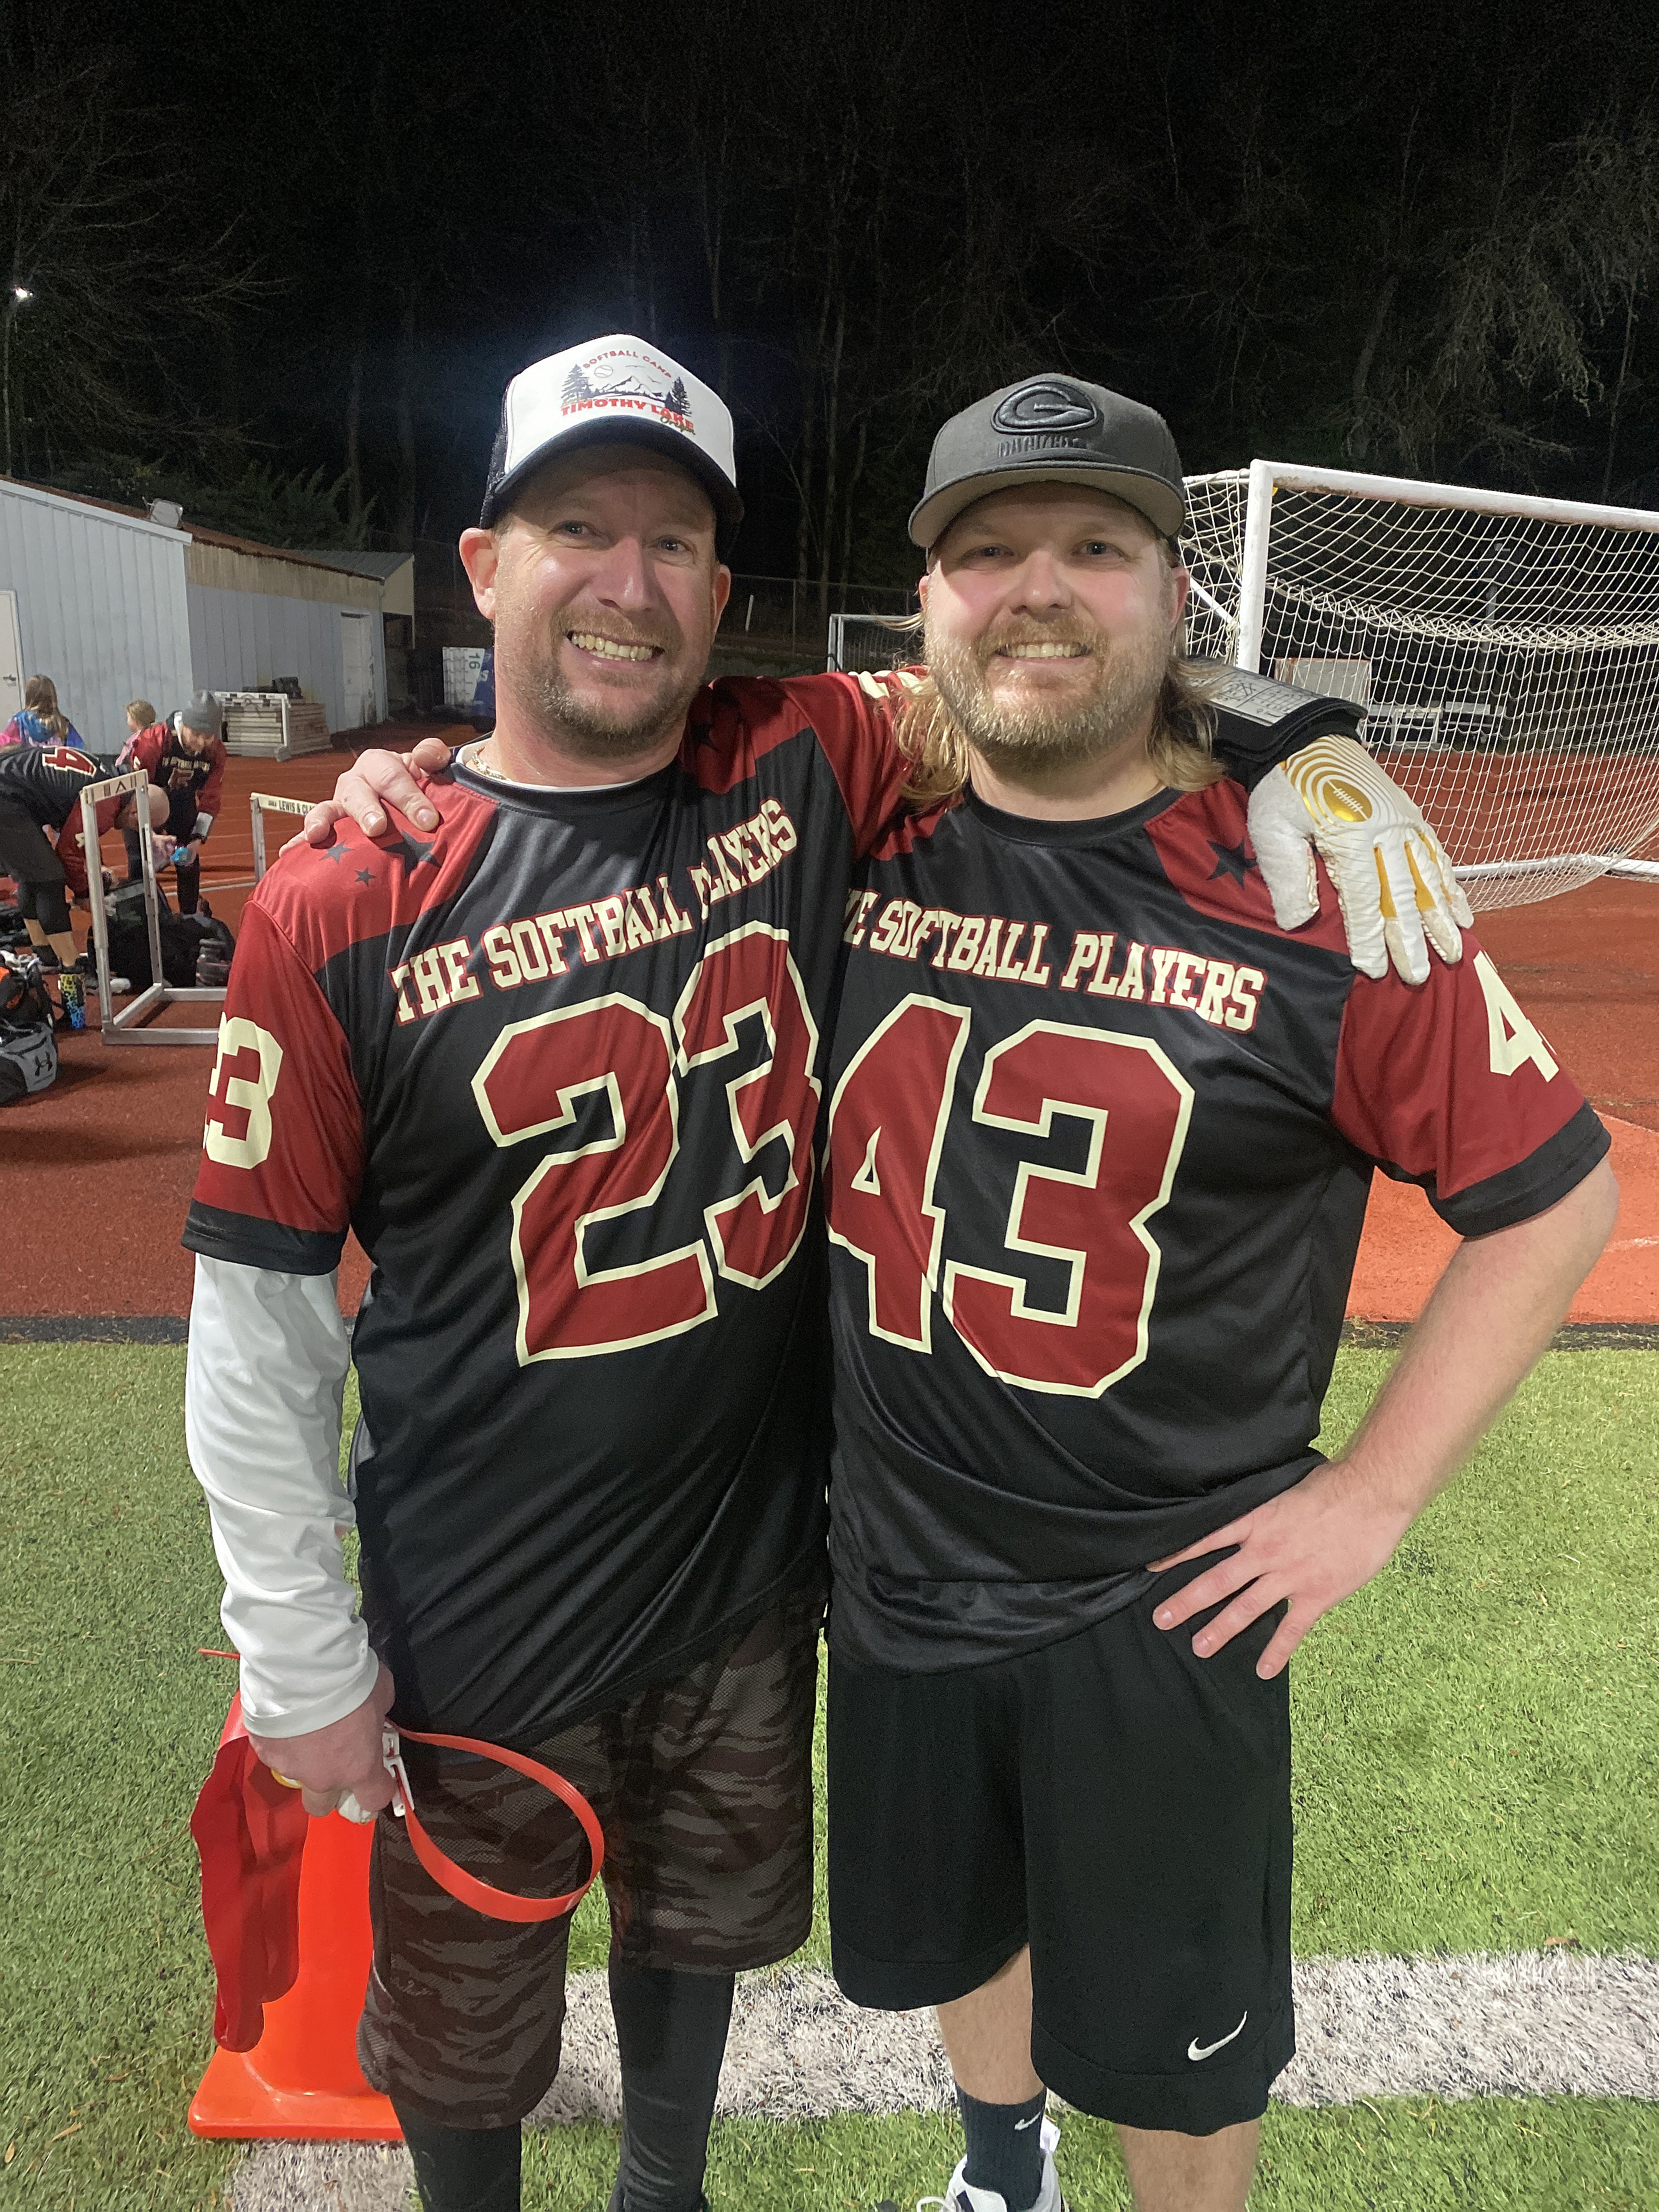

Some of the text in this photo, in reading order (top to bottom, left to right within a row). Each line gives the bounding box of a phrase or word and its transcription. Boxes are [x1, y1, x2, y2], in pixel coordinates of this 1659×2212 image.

[561, 399, 694, 430] TIMOTHY LAKE
[583, 350, 638, 369] SOFTBALL
[279, 800, 295, 812] LEWIS
[388, 936, 483, 1026] THE
[482, 874, 694, 990] SOFTBALL
[870, 897, 1053, 989] SOFTBALL
[1058, 930, 1267, 1032] PLAYERS
[471, 920, 822, 1367] 23
[822, 993, 1195, 1398] 43
